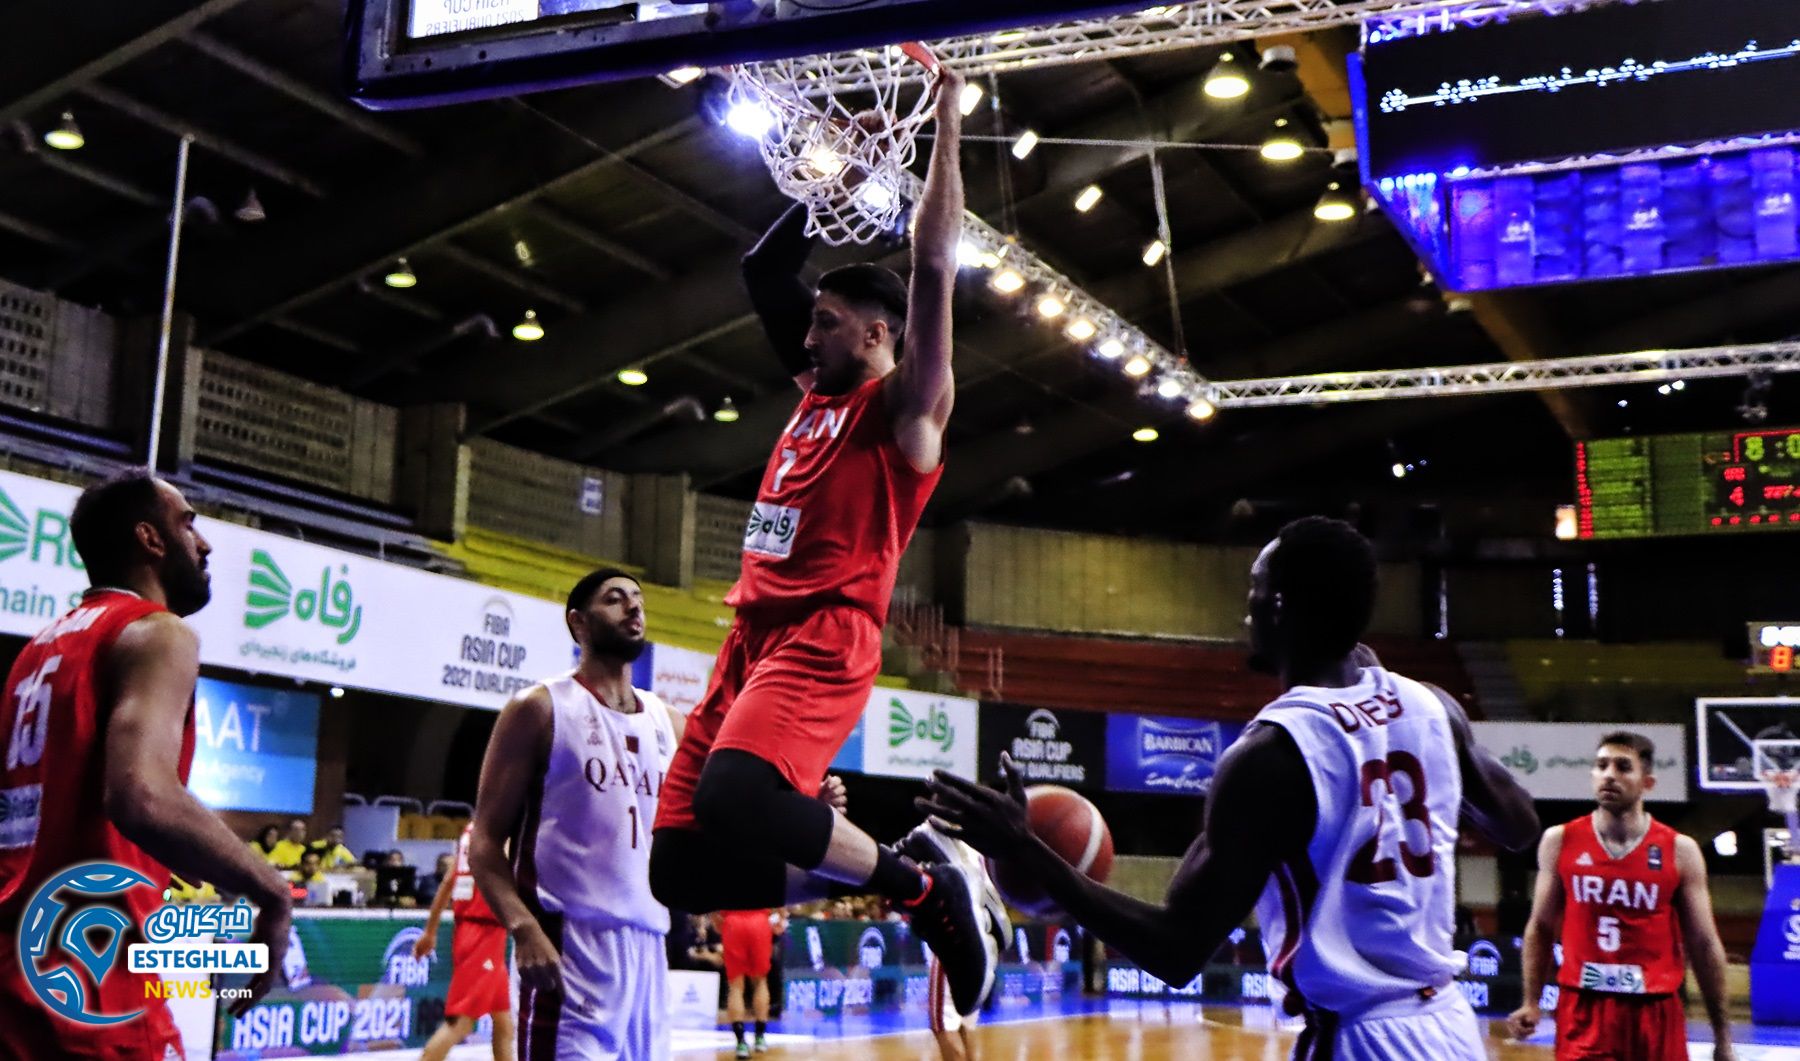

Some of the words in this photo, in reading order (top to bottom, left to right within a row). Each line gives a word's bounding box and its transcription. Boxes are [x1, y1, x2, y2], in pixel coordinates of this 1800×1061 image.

[771, 447, 797, 489] 7
[294, 563, 363, 645] رفاه
[460, 634, 496, 665] ASIA
[498, 641, 527, 670] CUP
[7, 654, 63, 772] 15
[915, 702, 955, 752] رفاه
[628, 805, 639, 850] 1
[1344, 750, 1435, 884] 23
[1572, 874, 1659, 911] IRAN
[1597, 916, 1621, 953] 5
[388, 953, 431, 987] FIBA
[1107, 967, 1139, 993] ASIA
[232, 1005, 295, 1050] ASIA
[301, 1001, 350, 1044] CUP
[351, 998, 412, 1039] 2021
